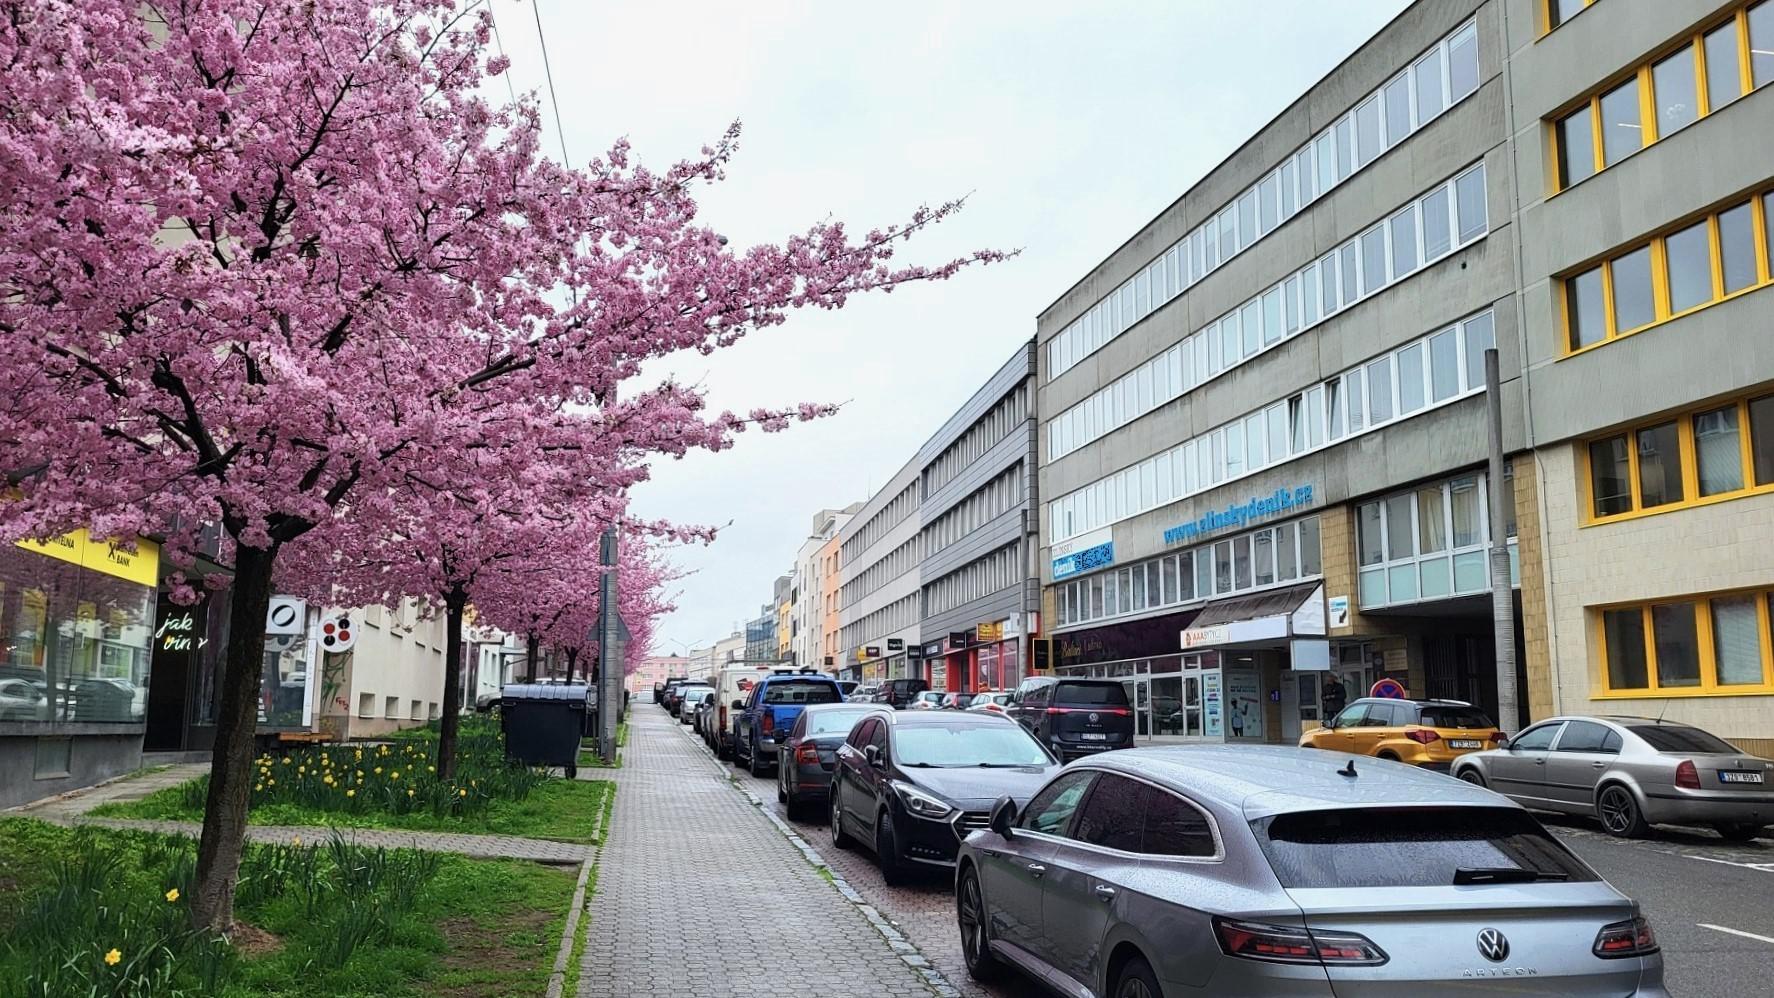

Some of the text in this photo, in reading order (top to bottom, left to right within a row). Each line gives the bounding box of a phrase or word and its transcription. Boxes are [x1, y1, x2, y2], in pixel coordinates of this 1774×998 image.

[116, 554, 131, 568] BANK
[155, 612, 193, 639] jak
[1463, 967, 1538, 977] ARTEON
